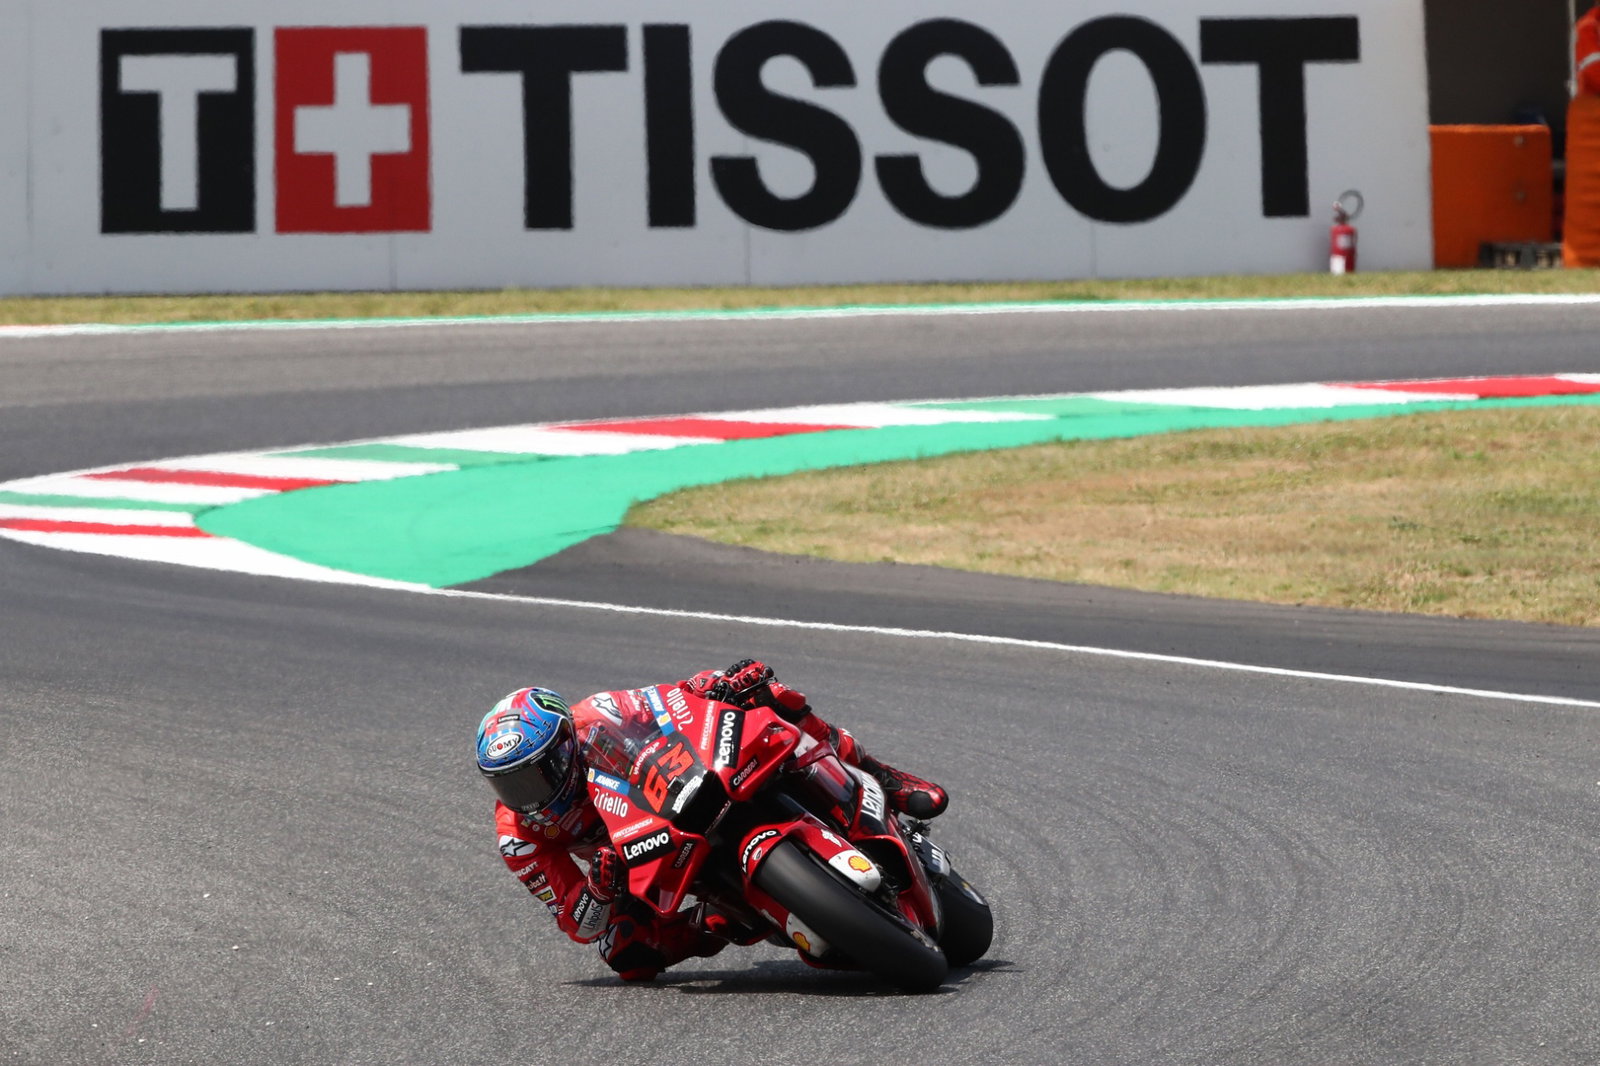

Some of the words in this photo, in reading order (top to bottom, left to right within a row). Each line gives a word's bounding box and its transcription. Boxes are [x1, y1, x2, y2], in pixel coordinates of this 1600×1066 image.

[459, 15, 1361, 231] TISSOT
[715, 711, 736, 766] Lenovo
[643, 742, 695, 814] 63
[623, 832, 669, 860] Lenovo
[674, 842, 693, 868] CARRERA
[742, 830, 777, 873] Lenovo
[515, 861, 539, 877] UCATI
[573, 893, 589, 921] Lenovo
